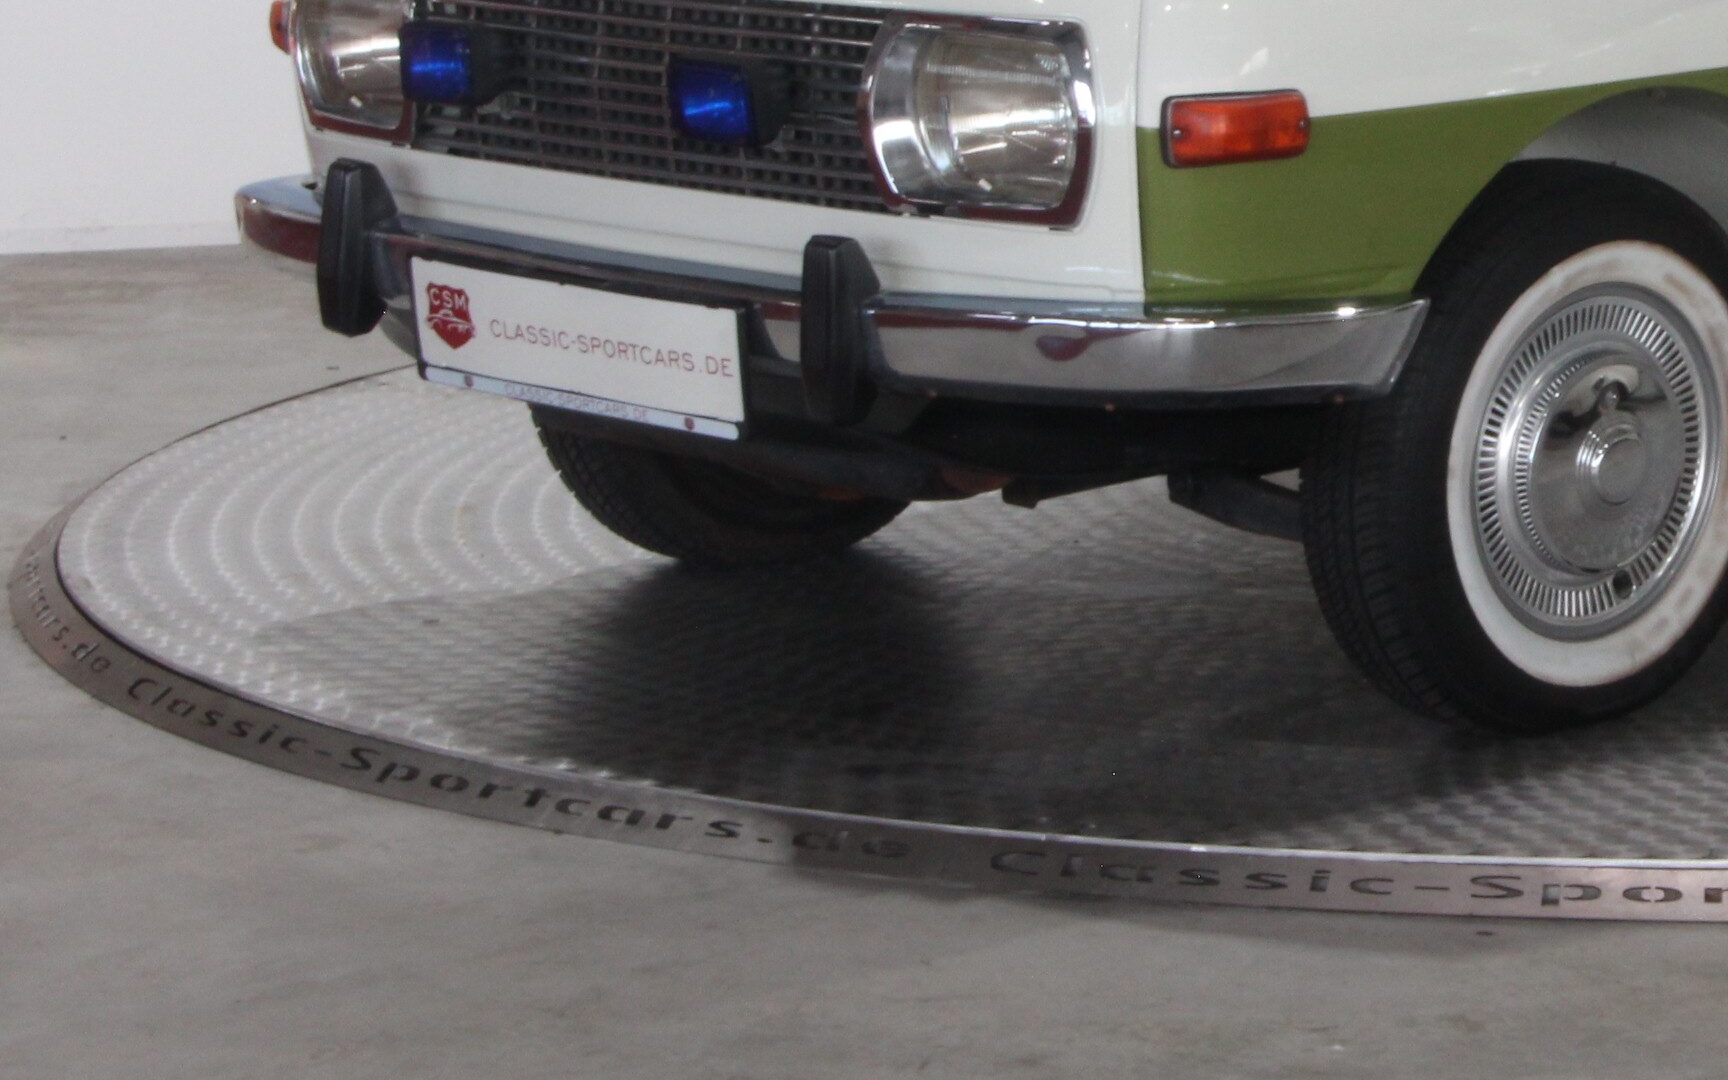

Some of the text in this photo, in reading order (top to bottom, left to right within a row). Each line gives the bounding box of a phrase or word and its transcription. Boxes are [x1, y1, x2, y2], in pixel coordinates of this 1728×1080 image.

[430, 287, 467, 310] CSM
[489, 319, 734, 378] CLASSIC-SPORTCARS.DE
[126, 676, 910, 858] Classic-Sportcars.de
